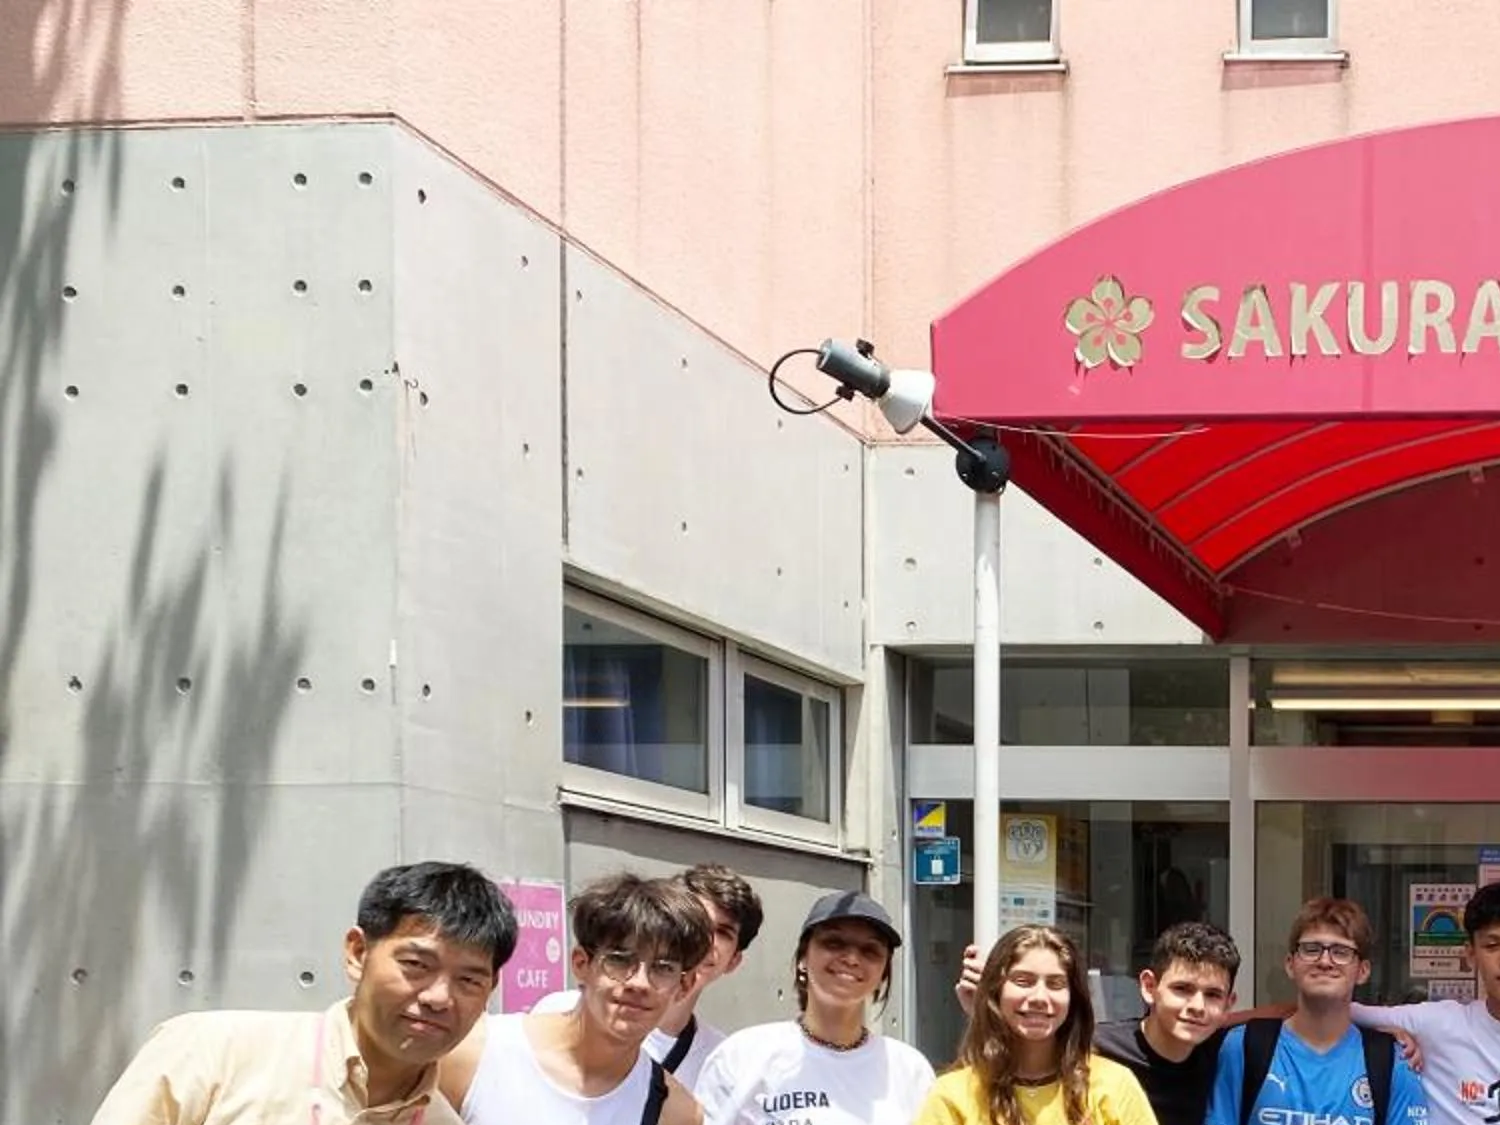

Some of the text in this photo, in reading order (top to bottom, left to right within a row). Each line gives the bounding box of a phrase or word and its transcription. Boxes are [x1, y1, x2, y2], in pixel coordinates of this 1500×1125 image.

[516, 910, 559, 929] UNDRY
[517, 967, 548, 988] CAFE
[763, 1091, 829, 1113] LIDERA
